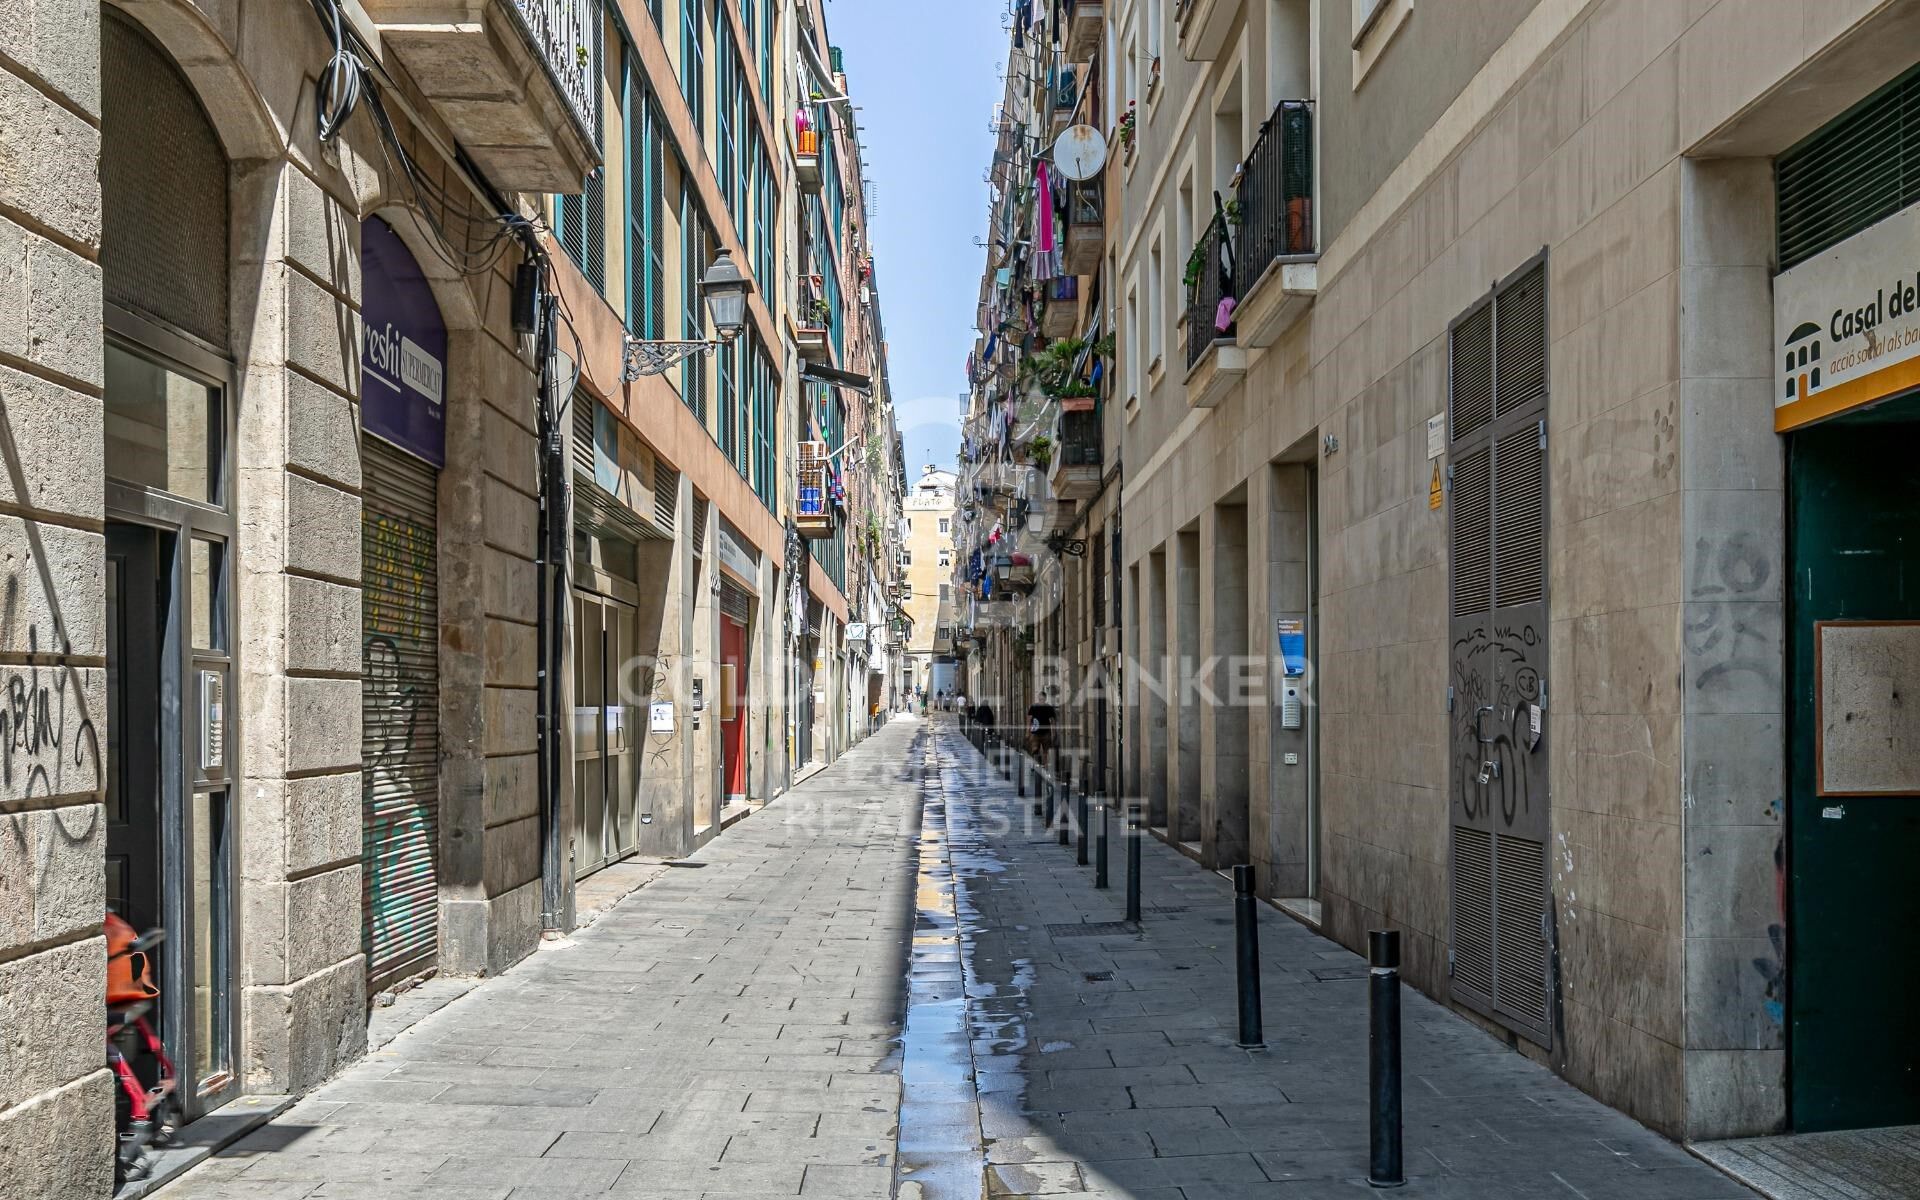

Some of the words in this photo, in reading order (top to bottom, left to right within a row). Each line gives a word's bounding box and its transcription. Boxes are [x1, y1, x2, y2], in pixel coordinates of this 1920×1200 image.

[1830, 288, 1883, 343] Casal
[402, 350, 441, 397] SUPERMERCAT
[1830, 349, 1855, 375] acció
[1887, 329, 1902, 353] als
[1904, 325, 1920, 347] ba
